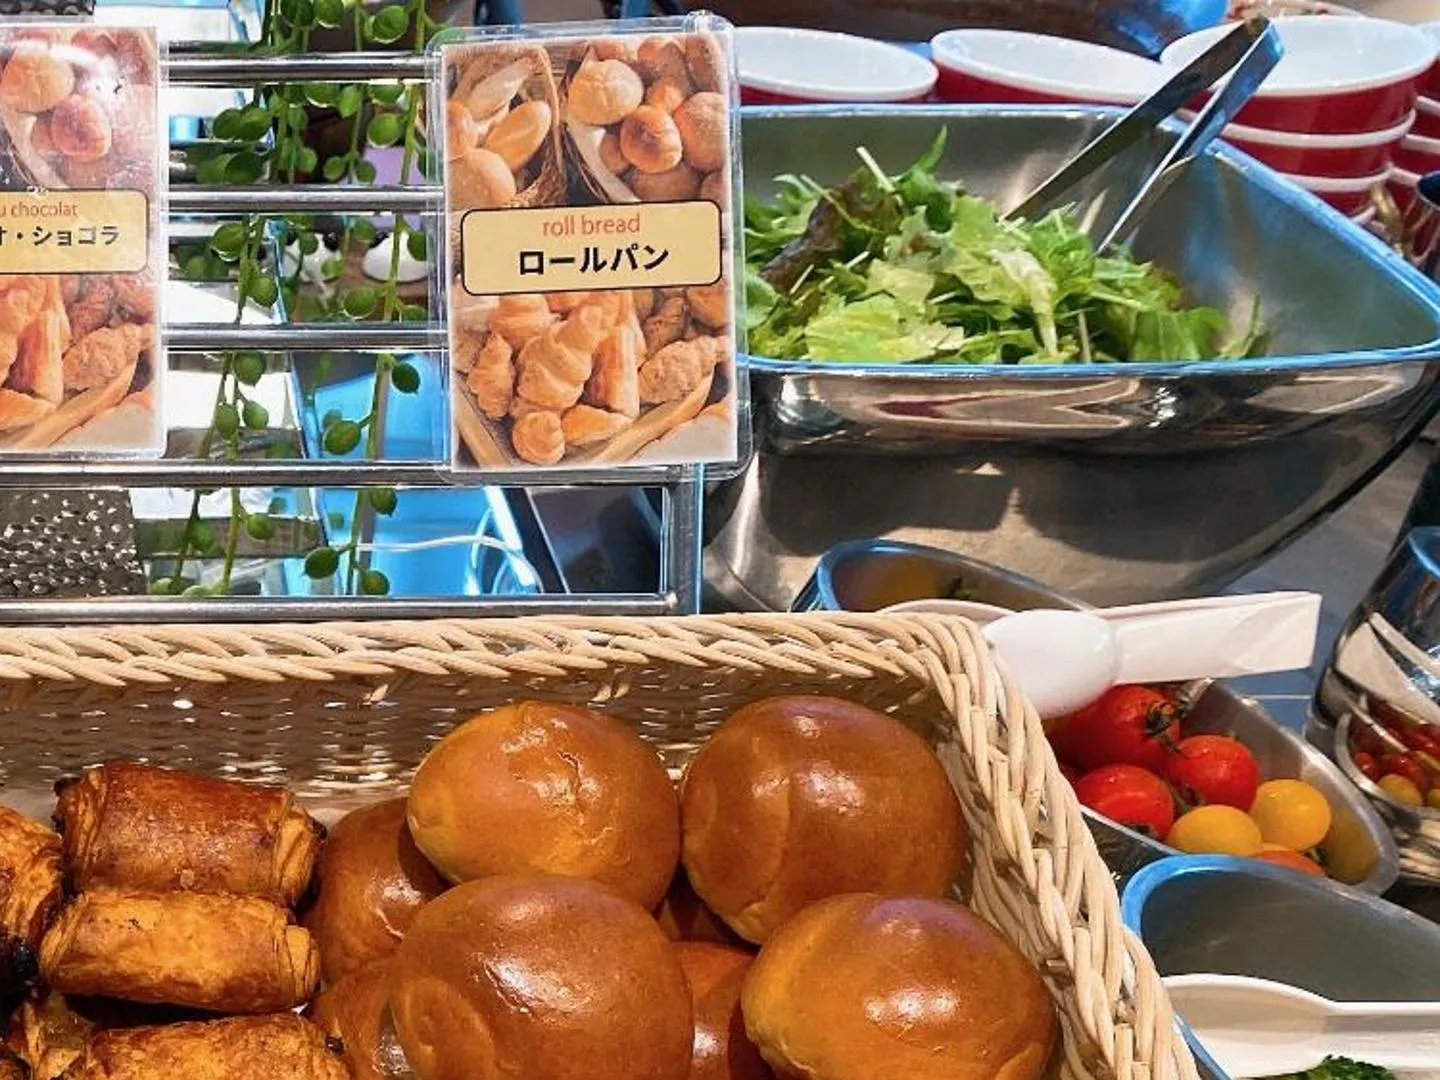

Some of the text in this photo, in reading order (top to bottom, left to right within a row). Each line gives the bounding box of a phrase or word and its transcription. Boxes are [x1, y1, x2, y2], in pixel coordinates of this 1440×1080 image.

[11, 201, 78, 218] chocolat
[542, 214, 641, 237] roll bread
[519, 242, 670, 275] ロールパン
